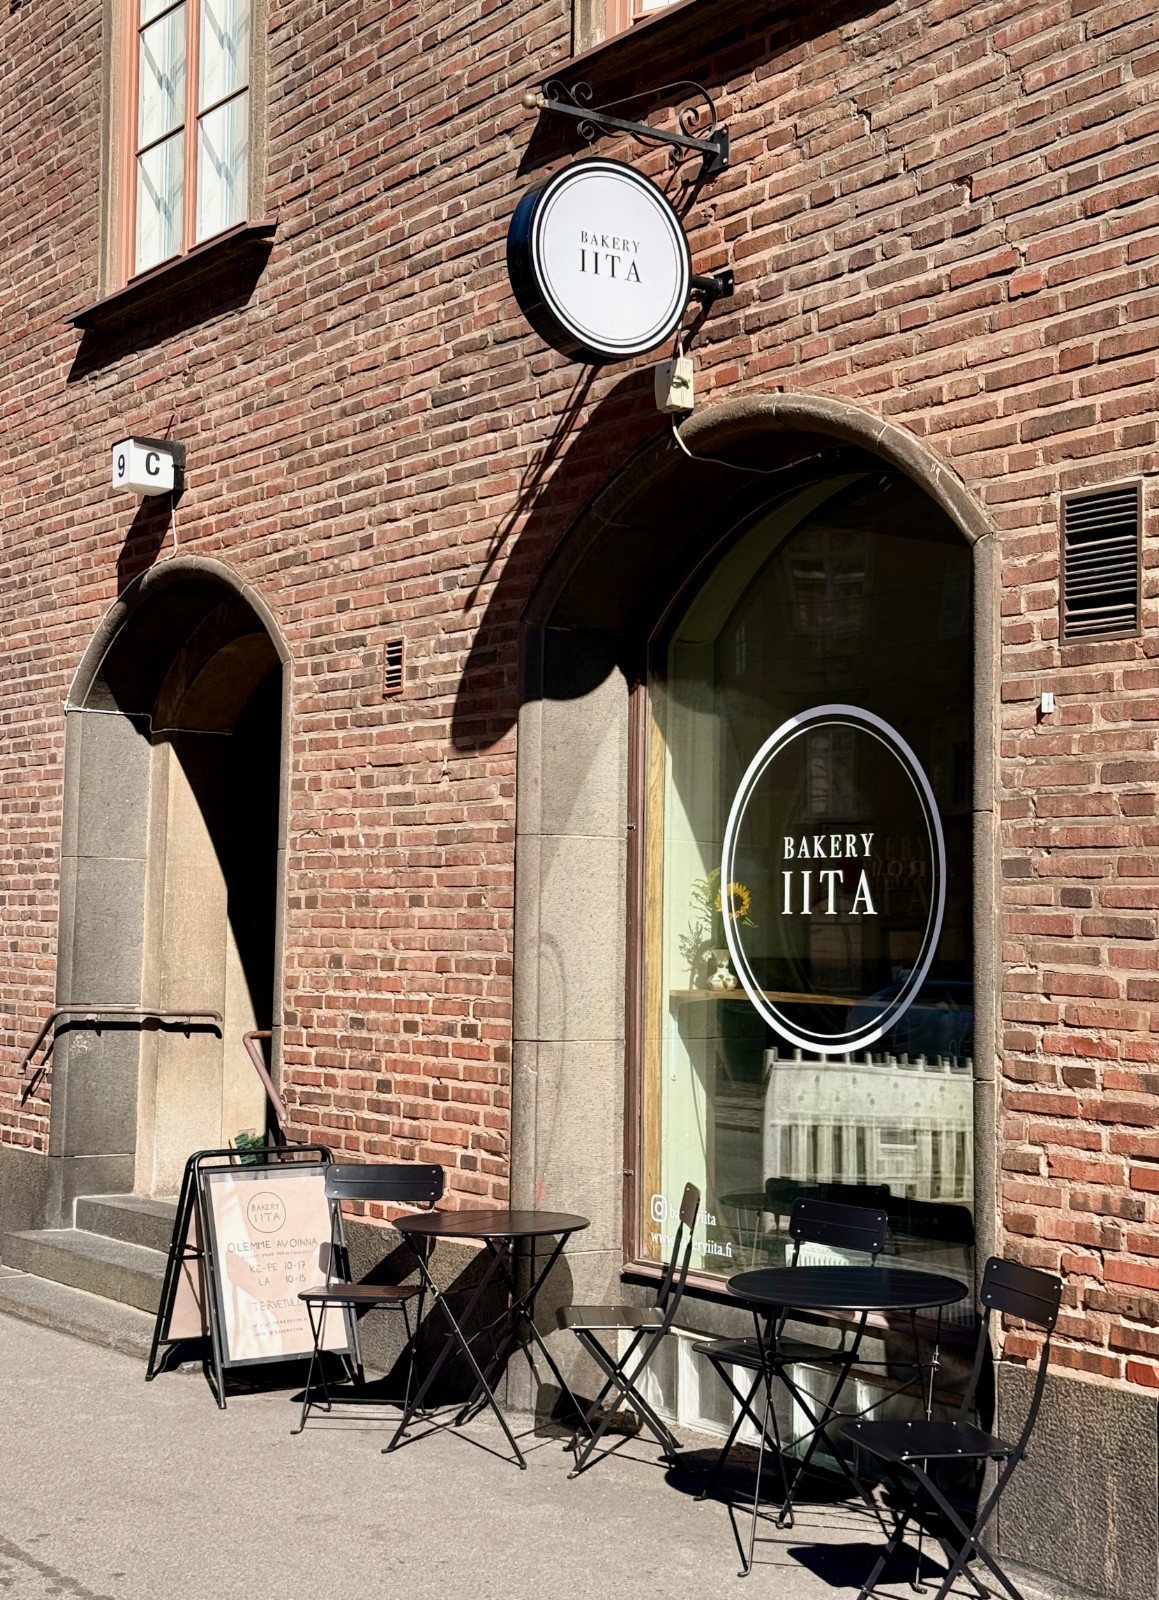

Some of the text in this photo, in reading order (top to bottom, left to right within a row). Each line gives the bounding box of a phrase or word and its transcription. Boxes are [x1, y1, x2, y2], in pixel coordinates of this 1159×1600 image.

[581, 230, 641, 254] BAKERY
[579, 248, 643, 284] IITA
[118, 454, 125, 478] 9
[145, 451, 160, 476] C
[783, 833, 875, 859] BAKERY
[781, 868, 879, 915] IITA
[251, 1203, 280, 1212] BAKERY
[254, 1212, 281, 1223] IITA
[669, 1203, 717, 1226] bayiita
[227, 1238, 318, 1253] OLEMME AVOINNA
[651, 1231, 733, 1258] wwwaeryiita.fi
[249, 1261, 306, 1274] KE-PE 10-17
[258, 1274, 306, 1286] LA 10-15
[252, 1298, 306, 1311] TERVETULO
